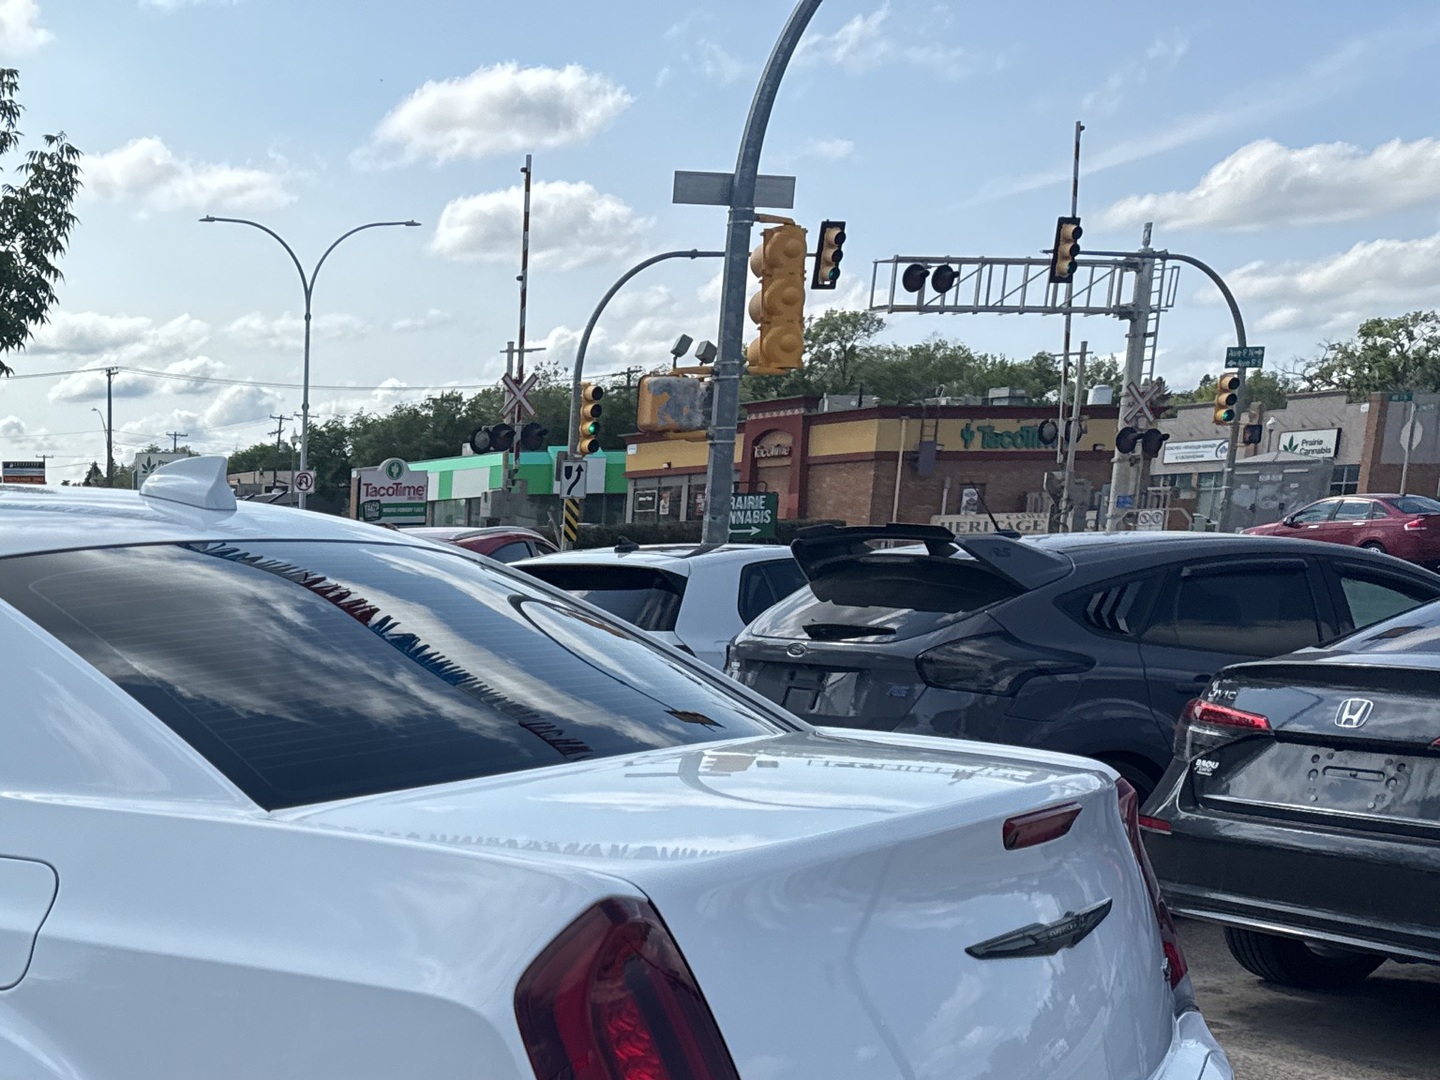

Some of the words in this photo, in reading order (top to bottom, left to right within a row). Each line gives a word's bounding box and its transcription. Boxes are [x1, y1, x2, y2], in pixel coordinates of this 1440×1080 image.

[363, 483, 424, 497] TacoTime
[731, 495, 766, 510] RAIRIE
[729, 510, 772, 525] NNABIS
[941, 520, 1044, 533] HERITAGE
